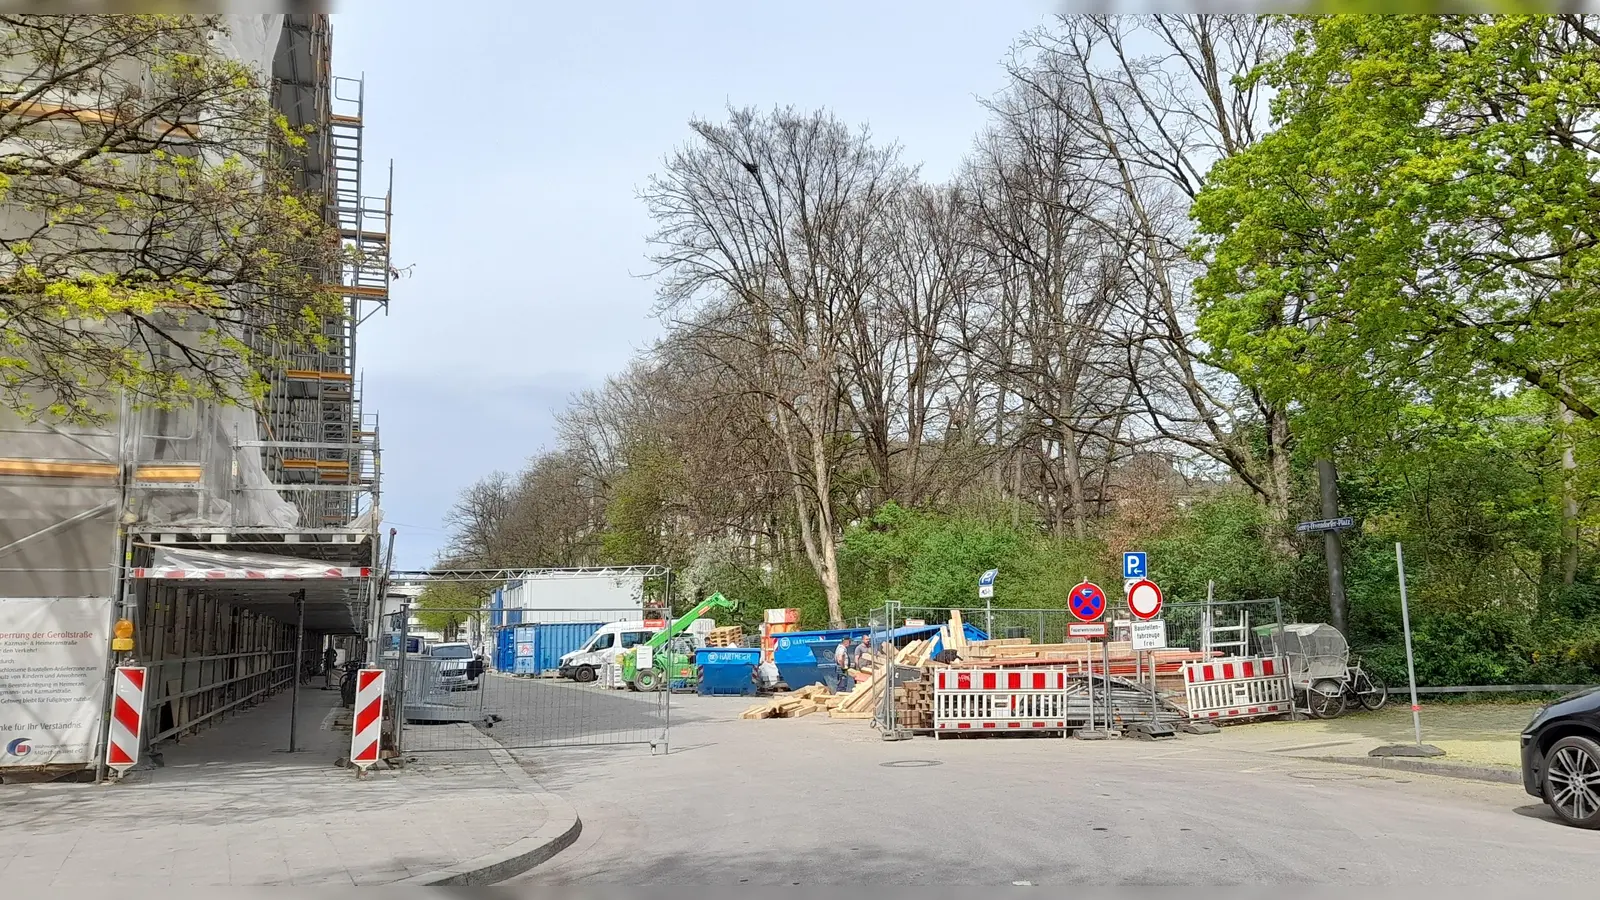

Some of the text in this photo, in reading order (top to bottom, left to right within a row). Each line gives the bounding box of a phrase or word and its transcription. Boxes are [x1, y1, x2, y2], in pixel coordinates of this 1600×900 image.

[1127, 556, 1140, 575] P
[47, 630, 93, 638] Geroltstraße
[14, 722, 26, 731] für
[27, 722, 39, 730] Ihr
